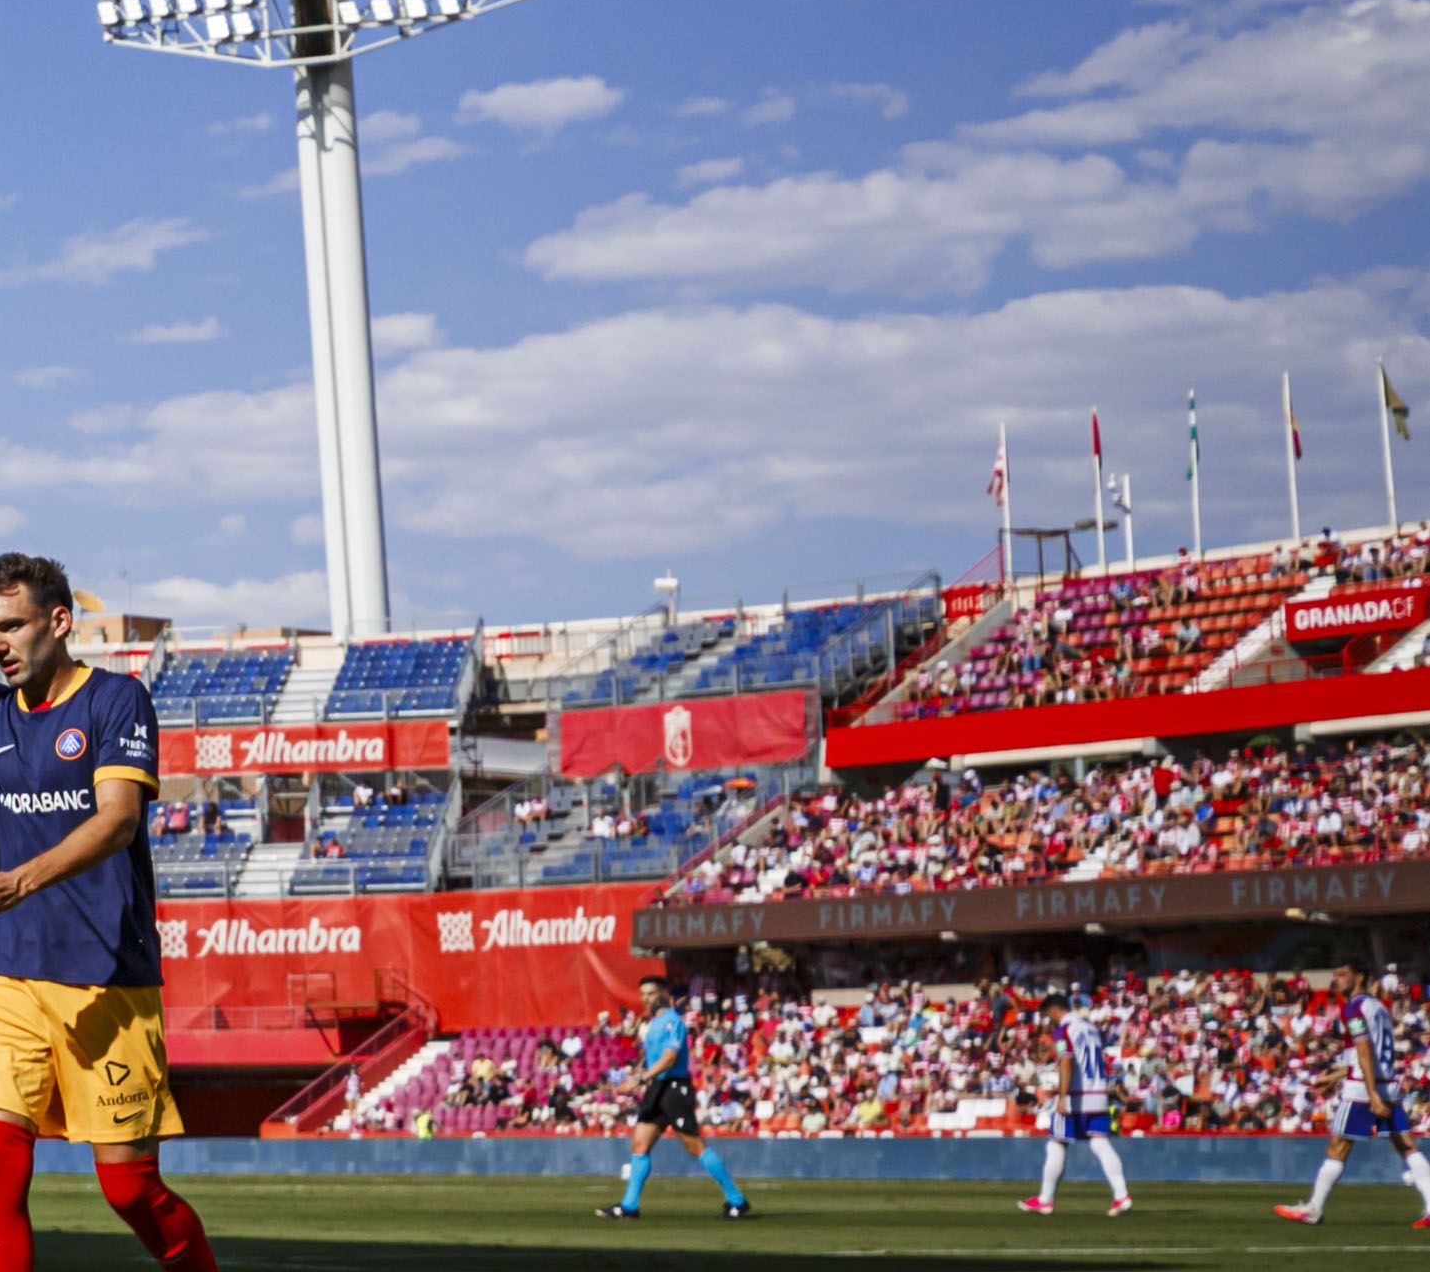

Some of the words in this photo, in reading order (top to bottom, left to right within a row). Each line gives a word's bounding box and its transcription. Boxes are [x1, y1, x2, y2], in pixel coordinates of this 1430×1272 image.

[240, 729, 384, 766] Alhambra
[1015, 884, 1167, 919] FIRMAFY
[1231, 872, 1396, 906] FIRMAFY
[480, 906, 616, 951] Alhambra
[637, 910, 767, 938] FIRMAFY
[819, 897, 957, 929] FIRMAFY
[196, 917, 361, 958] Alhambra
[96, 1090, 150, 1108] Andorra
